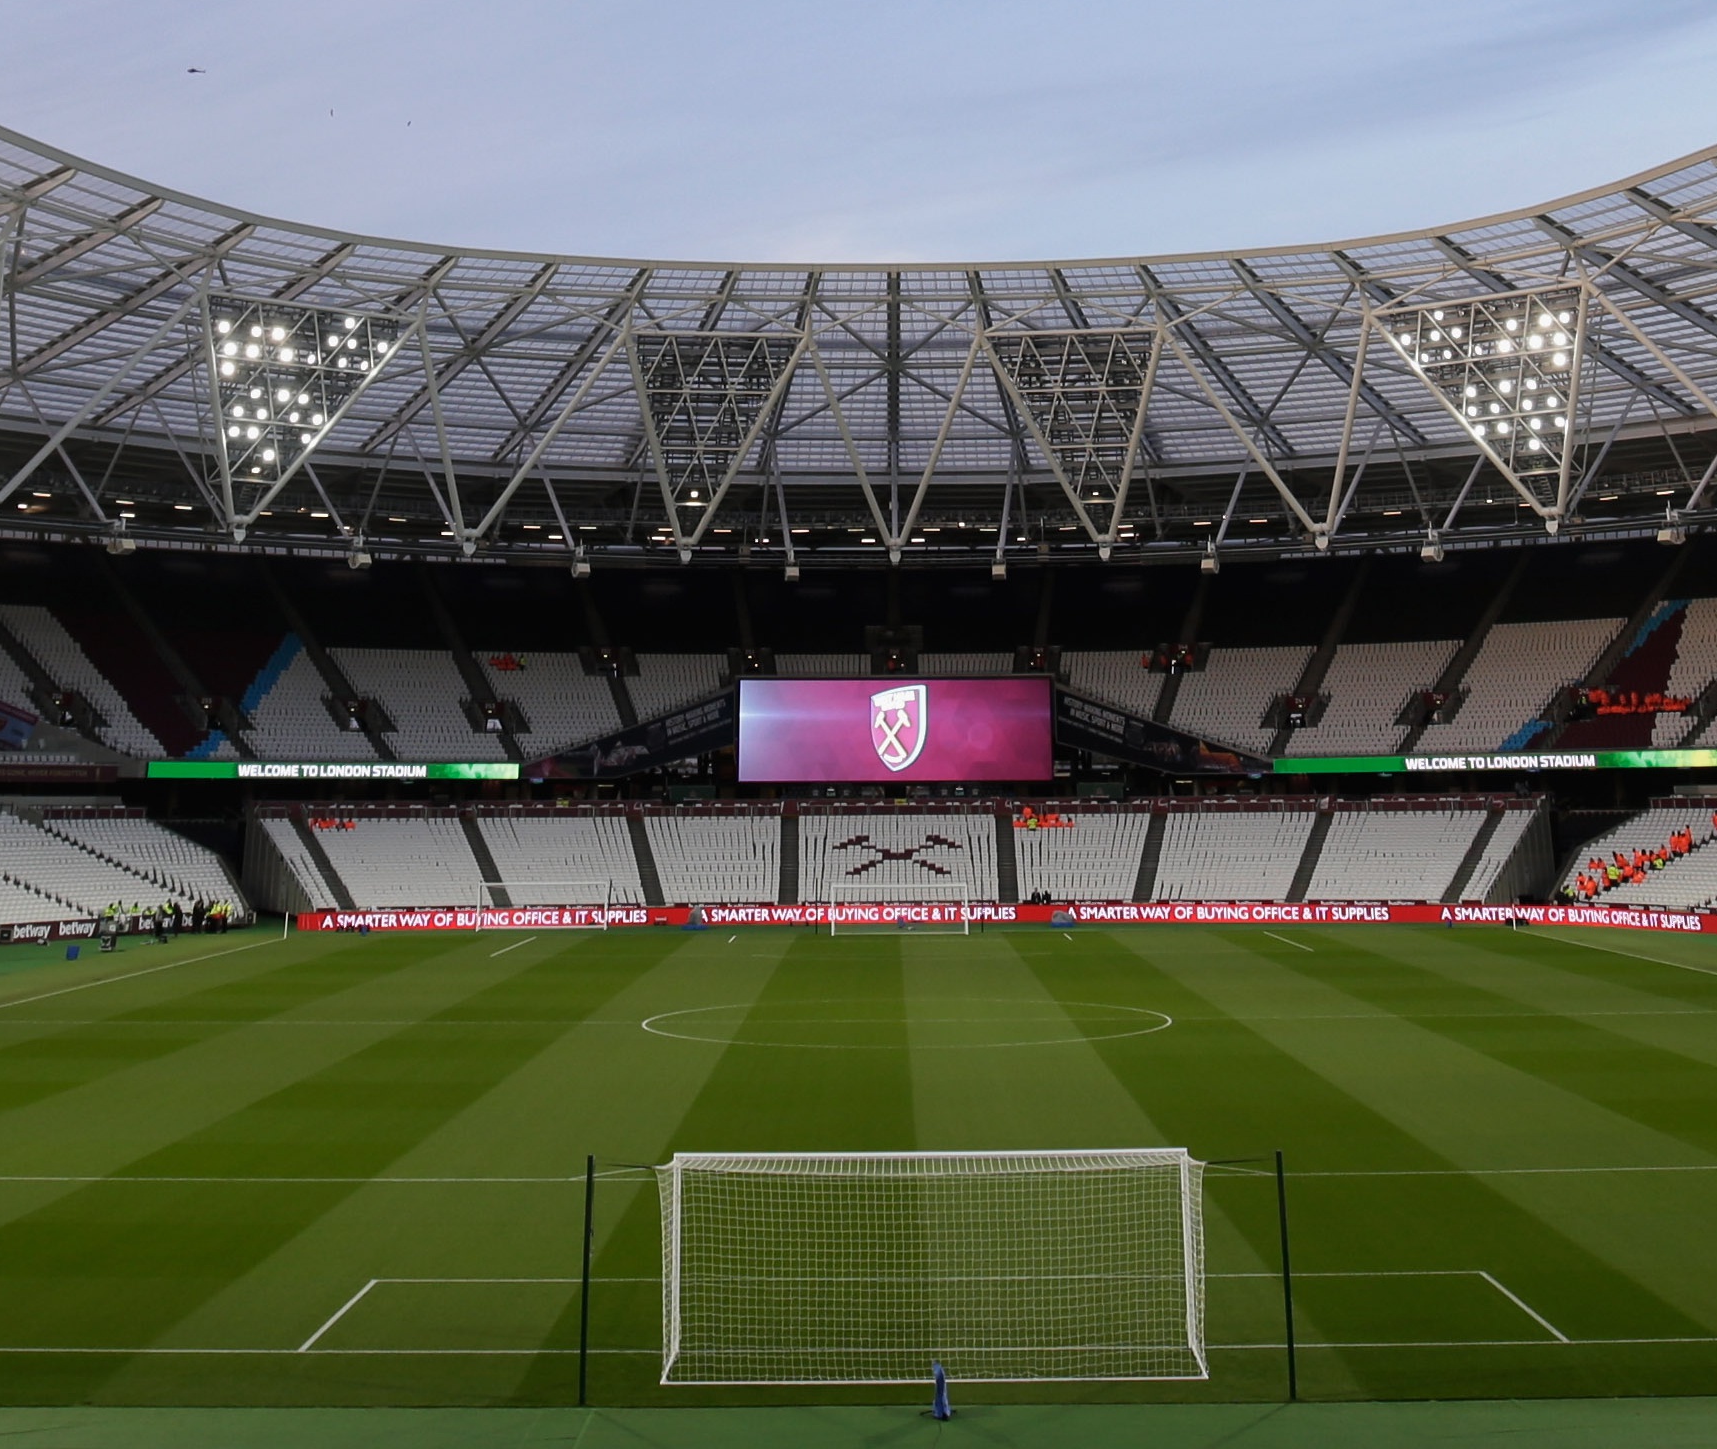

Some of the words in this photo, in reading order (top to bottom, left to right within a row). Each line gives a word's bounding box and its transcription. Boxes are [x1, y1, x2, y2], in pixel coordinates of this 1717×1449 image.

[1404, 757, 1465, 770] WELCOME
[1467, 756, 1483, 769] TO
[1485, 756, 1537, 768] LONDON
[1540, 755, 1596, 768] STADIUM
[238, 764, 299, 778] WELCOME
[301, 764, 318, 778] TO
[319, 765, 371, 778] LONDON
[372, 765, 427, 778] STADIUM
[336, 914, 398, 928] SMARTER
[398, 913, 431, 927] WAY
[434, 913, 454, 927] OF
[456, 912, 508, 926] BUYING
[512, 911, 561, 924] OFFICE
[575, 910, 586, 923] IT
[591, 909, 647, 923] SUPPLIES
[711, 908, 770, 922] SMARTER
[772, 908, 803, 921] WAY
[806, 908, 825, 921] OF
[828, 907, 879, 920] BUYING
[882, 907, 928, 920] OFFICE
[944, 907, 957, 920] IT
[961, 907, 1016, 920] SUPPLIES
[1080, 907, 1138, 919] SMARTER
[1140, 907, 1170, 919] WAY
[1174, 907, 1193, 919] OF
[1196, 907, 1249, 919] BUYING
[1252, 907, 1299, 920] OFFICE
[1316, 907, 1328, 920] IT
[1332, 907, 1389, 920] SUPPLIES
[1454, 907, 1514, 921] SMARTER
[1515, 908, 1544, 921] WAY
[1548, 908, 1566, 922] OF
[1568, 909, 1609, 925] BUYING
[1611, 913, 1640, 927] OFFICE
[1649, 914, 1659, 928] IT
[1660, 915, 1701, 931] SUPPLIES
[13, 924, 51, 940] betway
[58, 921, 97, 938] betway
